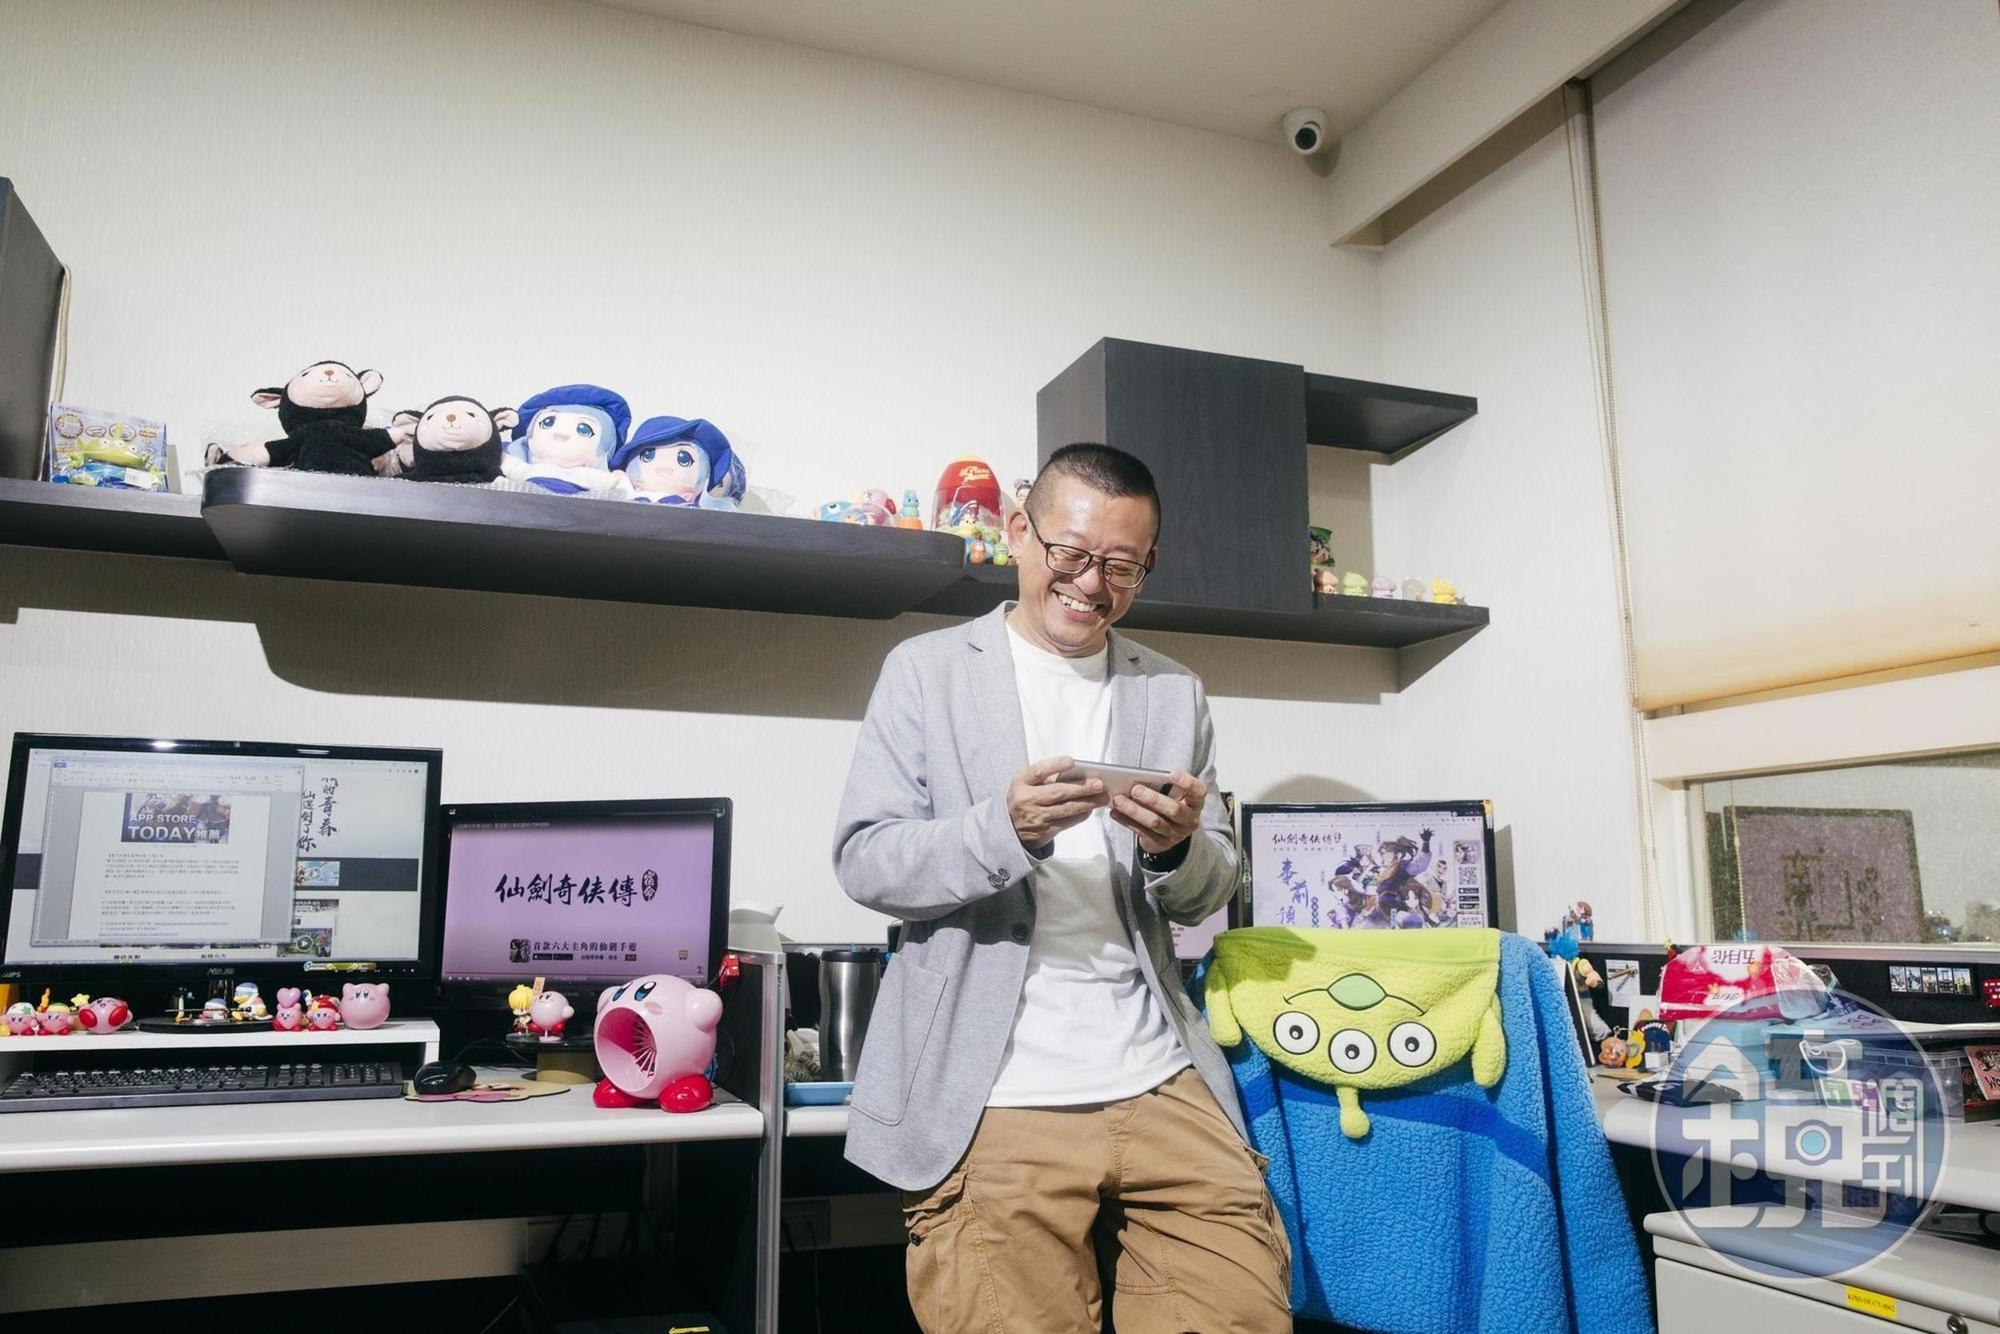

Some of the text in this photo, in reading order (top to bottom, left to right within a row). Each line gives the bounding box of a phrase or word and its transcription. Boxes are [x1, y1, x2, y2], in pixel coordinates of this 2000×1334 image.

[156, 814, 196, 823] STORE
[128, 826, 196, 841] TODAY
[495, 873, 638, 907] 仙劍奇俠傳
